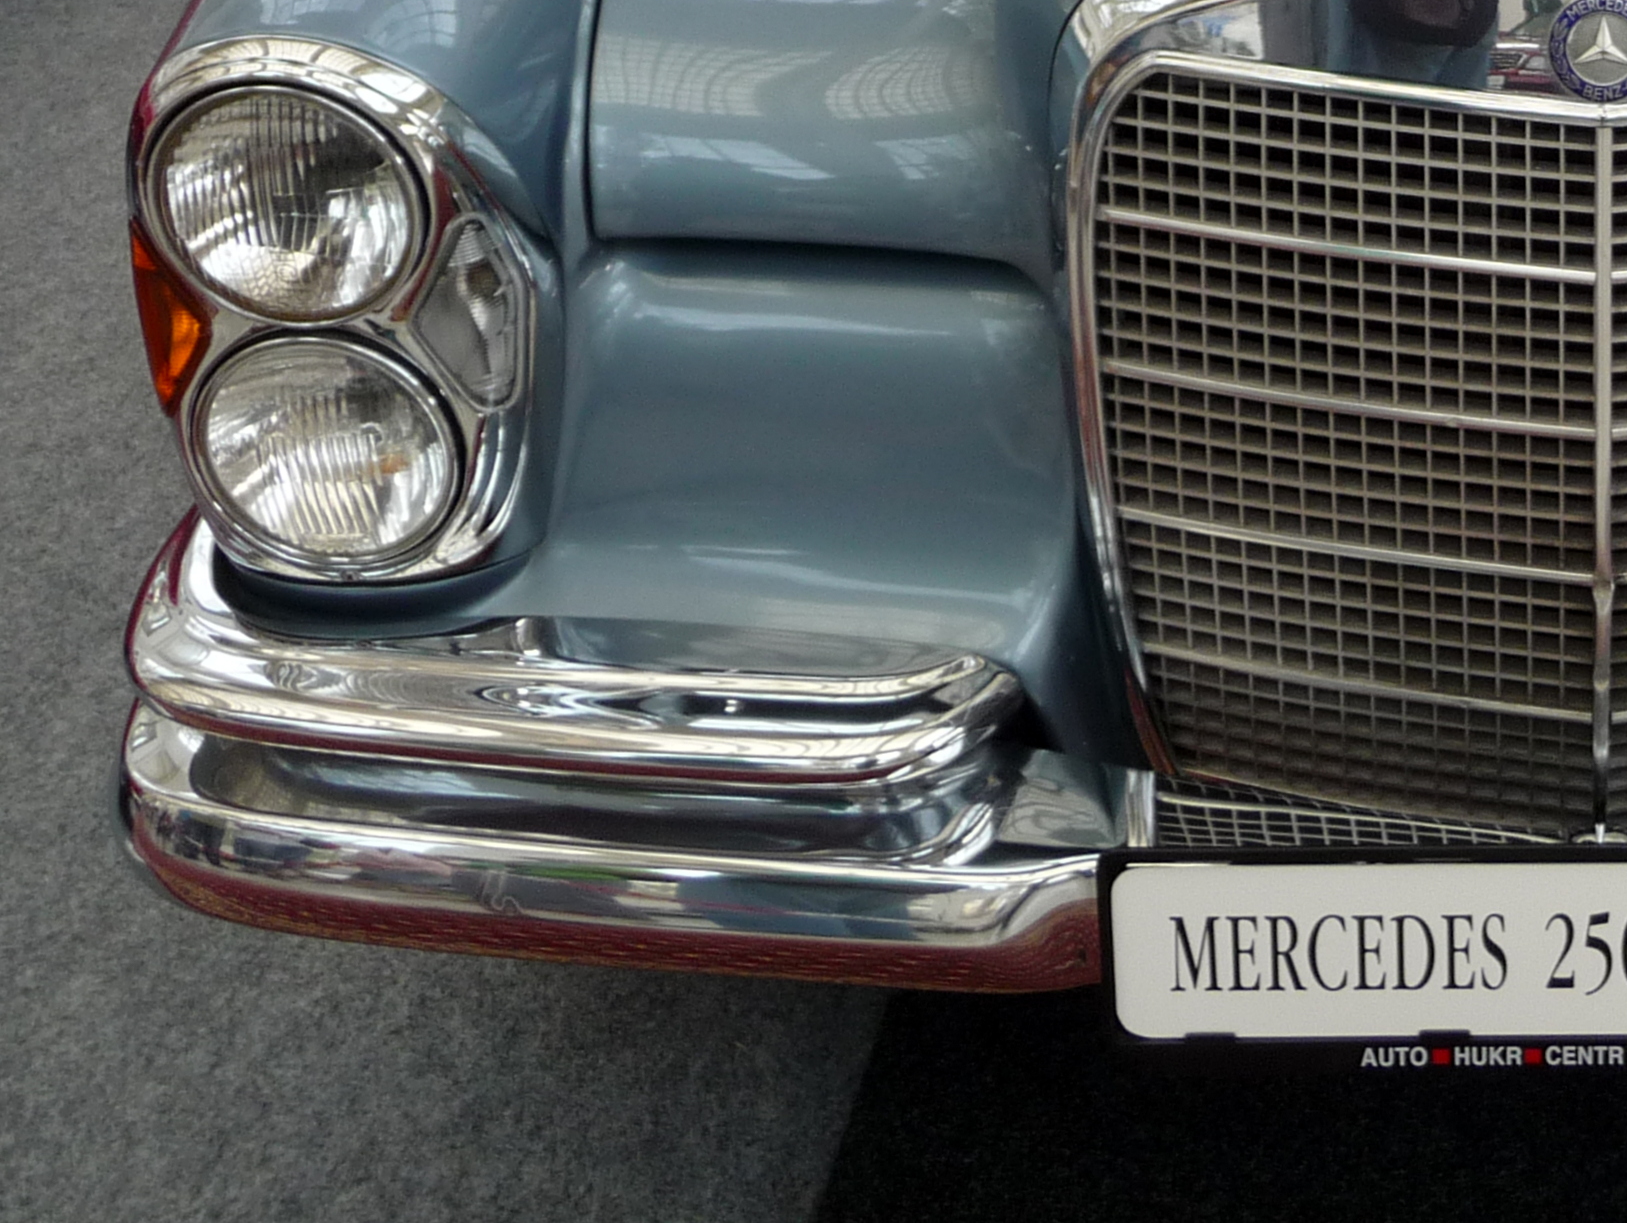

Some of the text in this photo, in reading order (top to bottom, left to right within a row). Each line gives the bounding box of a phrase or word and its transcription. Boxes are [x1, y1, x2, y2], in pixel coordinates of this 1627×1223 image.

[1583, 85, 1624, 101] BENZ
[1168, 913, 1508, 992] MERCEDES
[1360, 1046, 1429, 1067] AUTO
[1454, 1045, 1523, 1066] HUKR
[1545, 1045, 1624, 1066] CENTR
